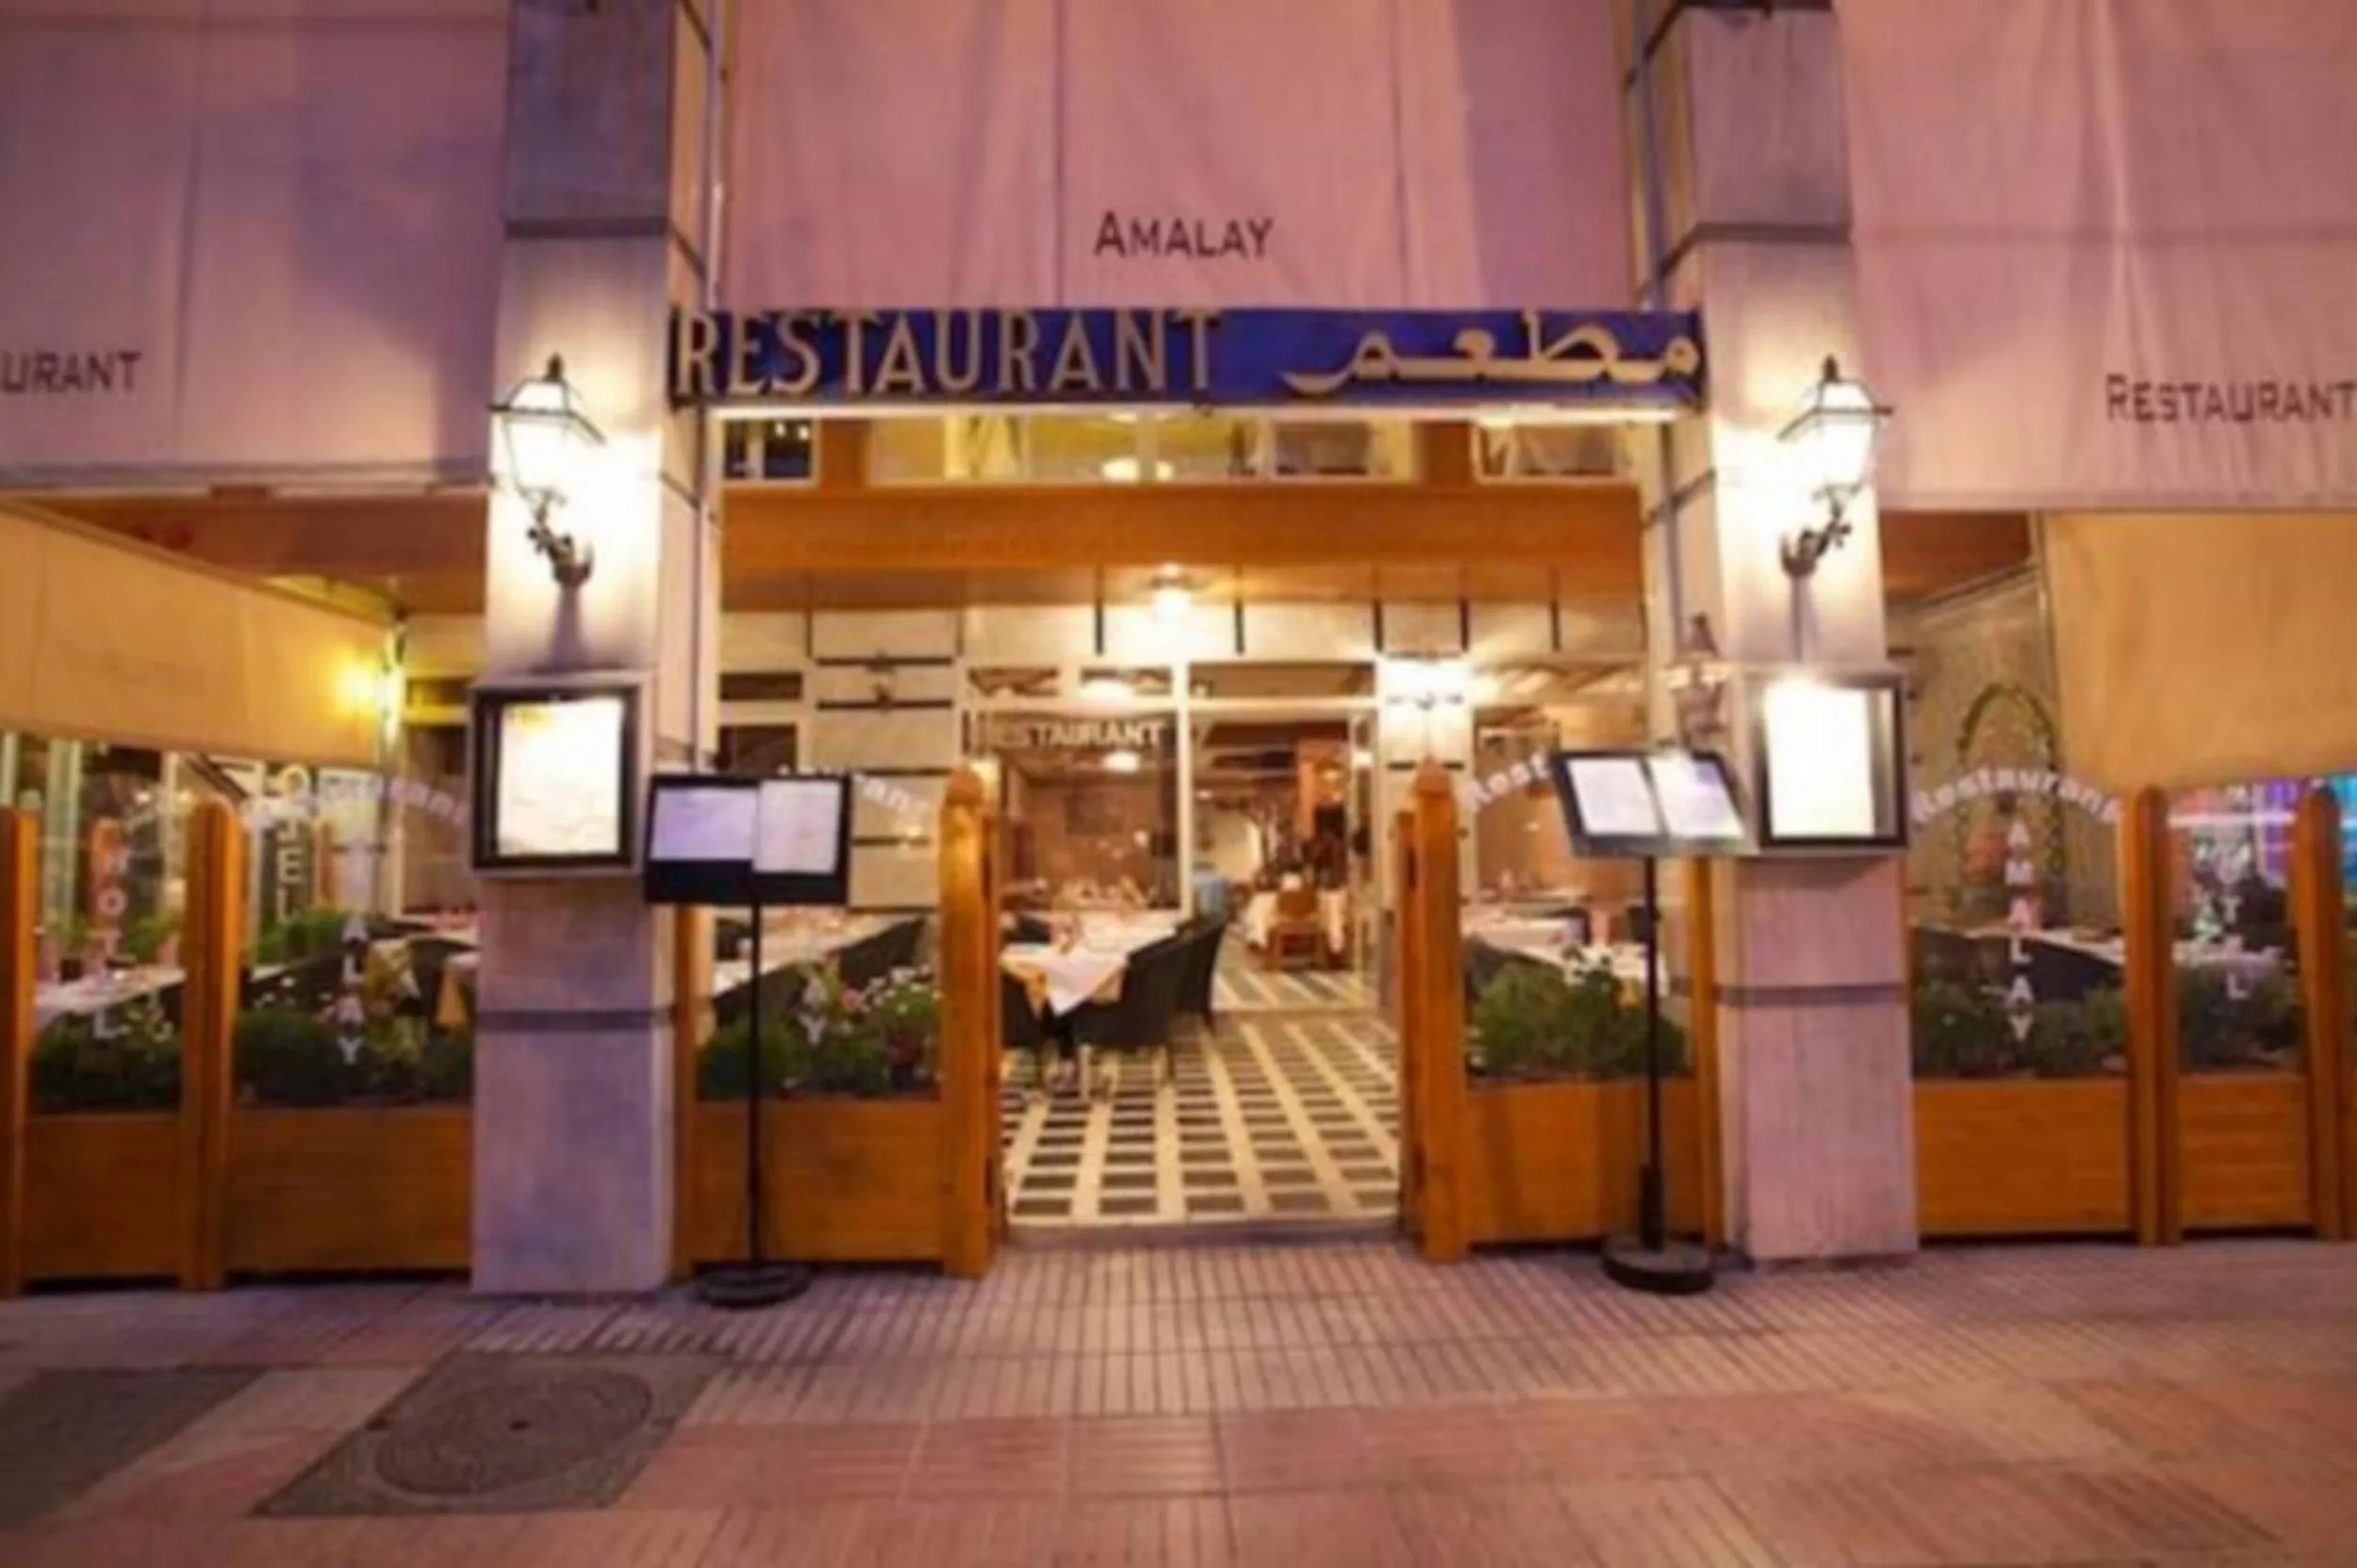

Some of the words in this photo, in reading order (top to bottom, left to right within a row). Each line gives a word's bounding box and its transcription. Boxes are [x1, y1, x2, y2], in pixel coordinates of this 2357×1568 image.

[1093, 209, 1274, 257] AMALAY
[1, 350, 141, 394] URANT
[676, 308, 1225, 394] RESTAURANT
[1281, 307, 1698, 394] مطعم
[2105, 373, 2357, 421] RESTAURANT
[1906, 767, 2125, 825] Restaurant
[2003, 821, 2036, 1040] AMALAY
